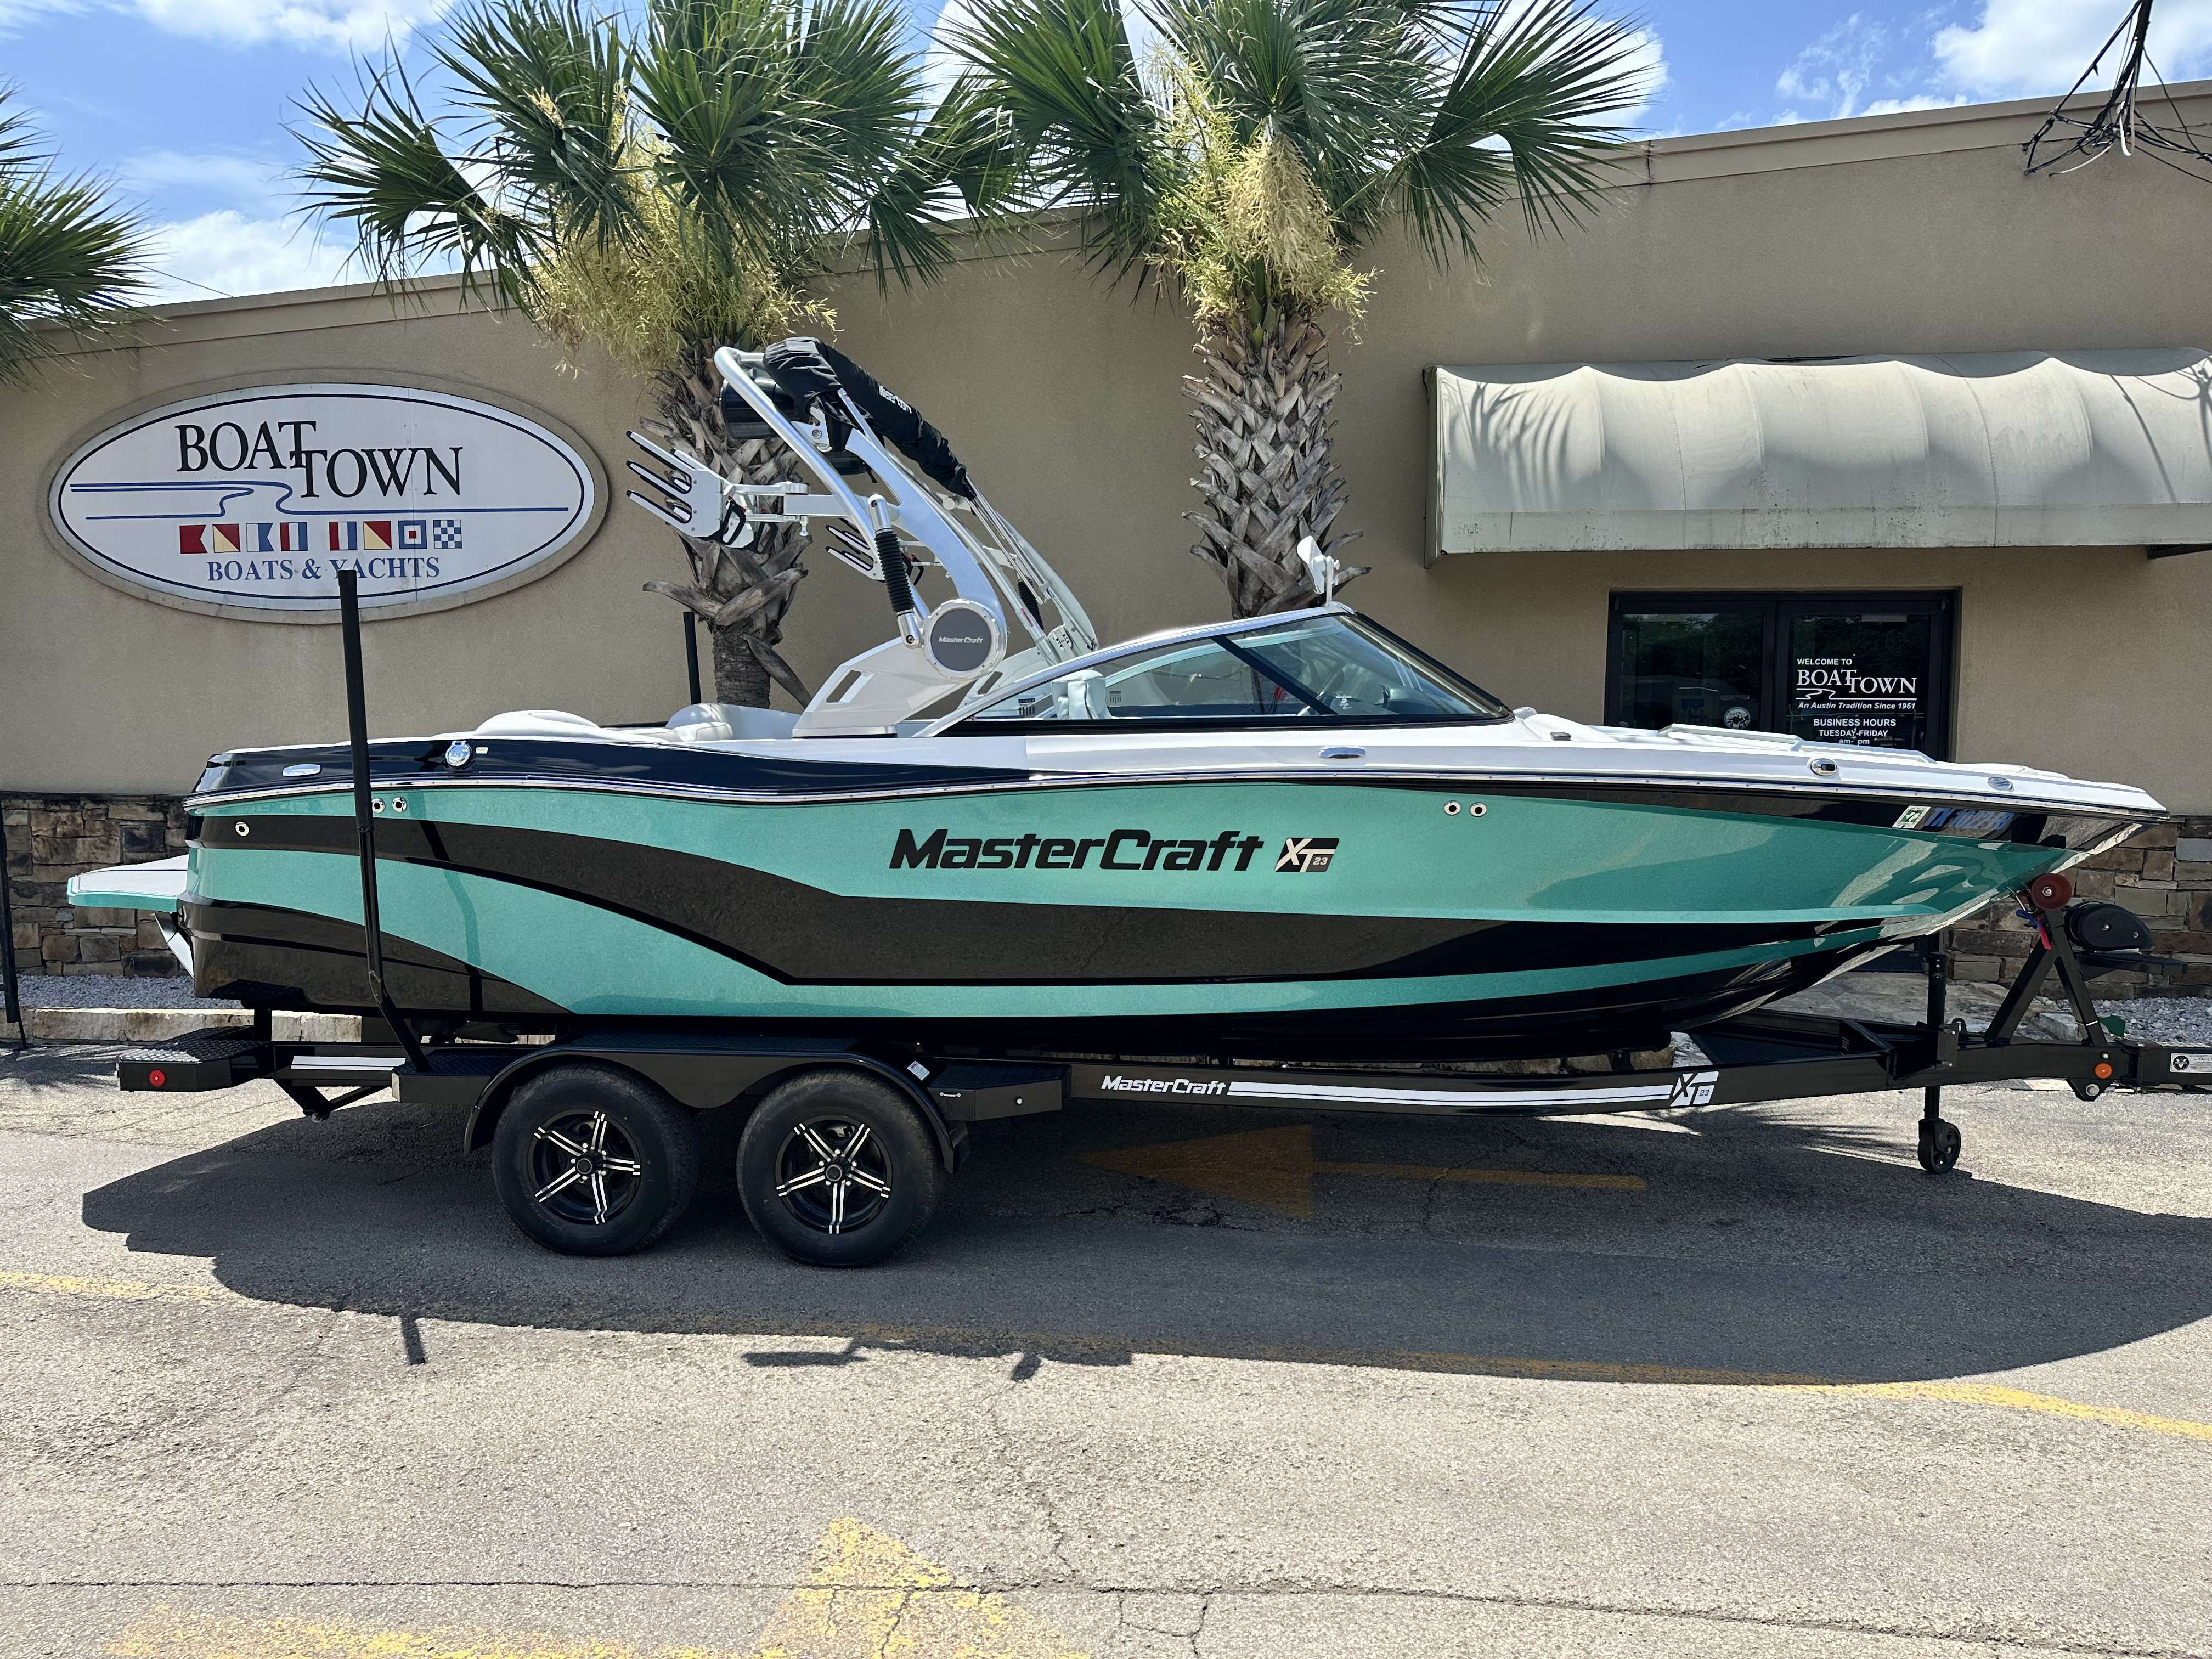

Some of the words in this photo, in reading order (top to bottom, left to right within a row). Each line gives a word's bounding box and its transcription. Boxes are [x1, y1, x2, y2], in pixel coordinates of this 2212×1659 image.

[207, 559, 293, 581] BOATS
[302, 558, 321, 580] &
[329, 557, 439, 579] YACHTS
[889, 828, 1264, 871] MasterCraft
[1101, 1075, 1226, 1095] MasterCraft
